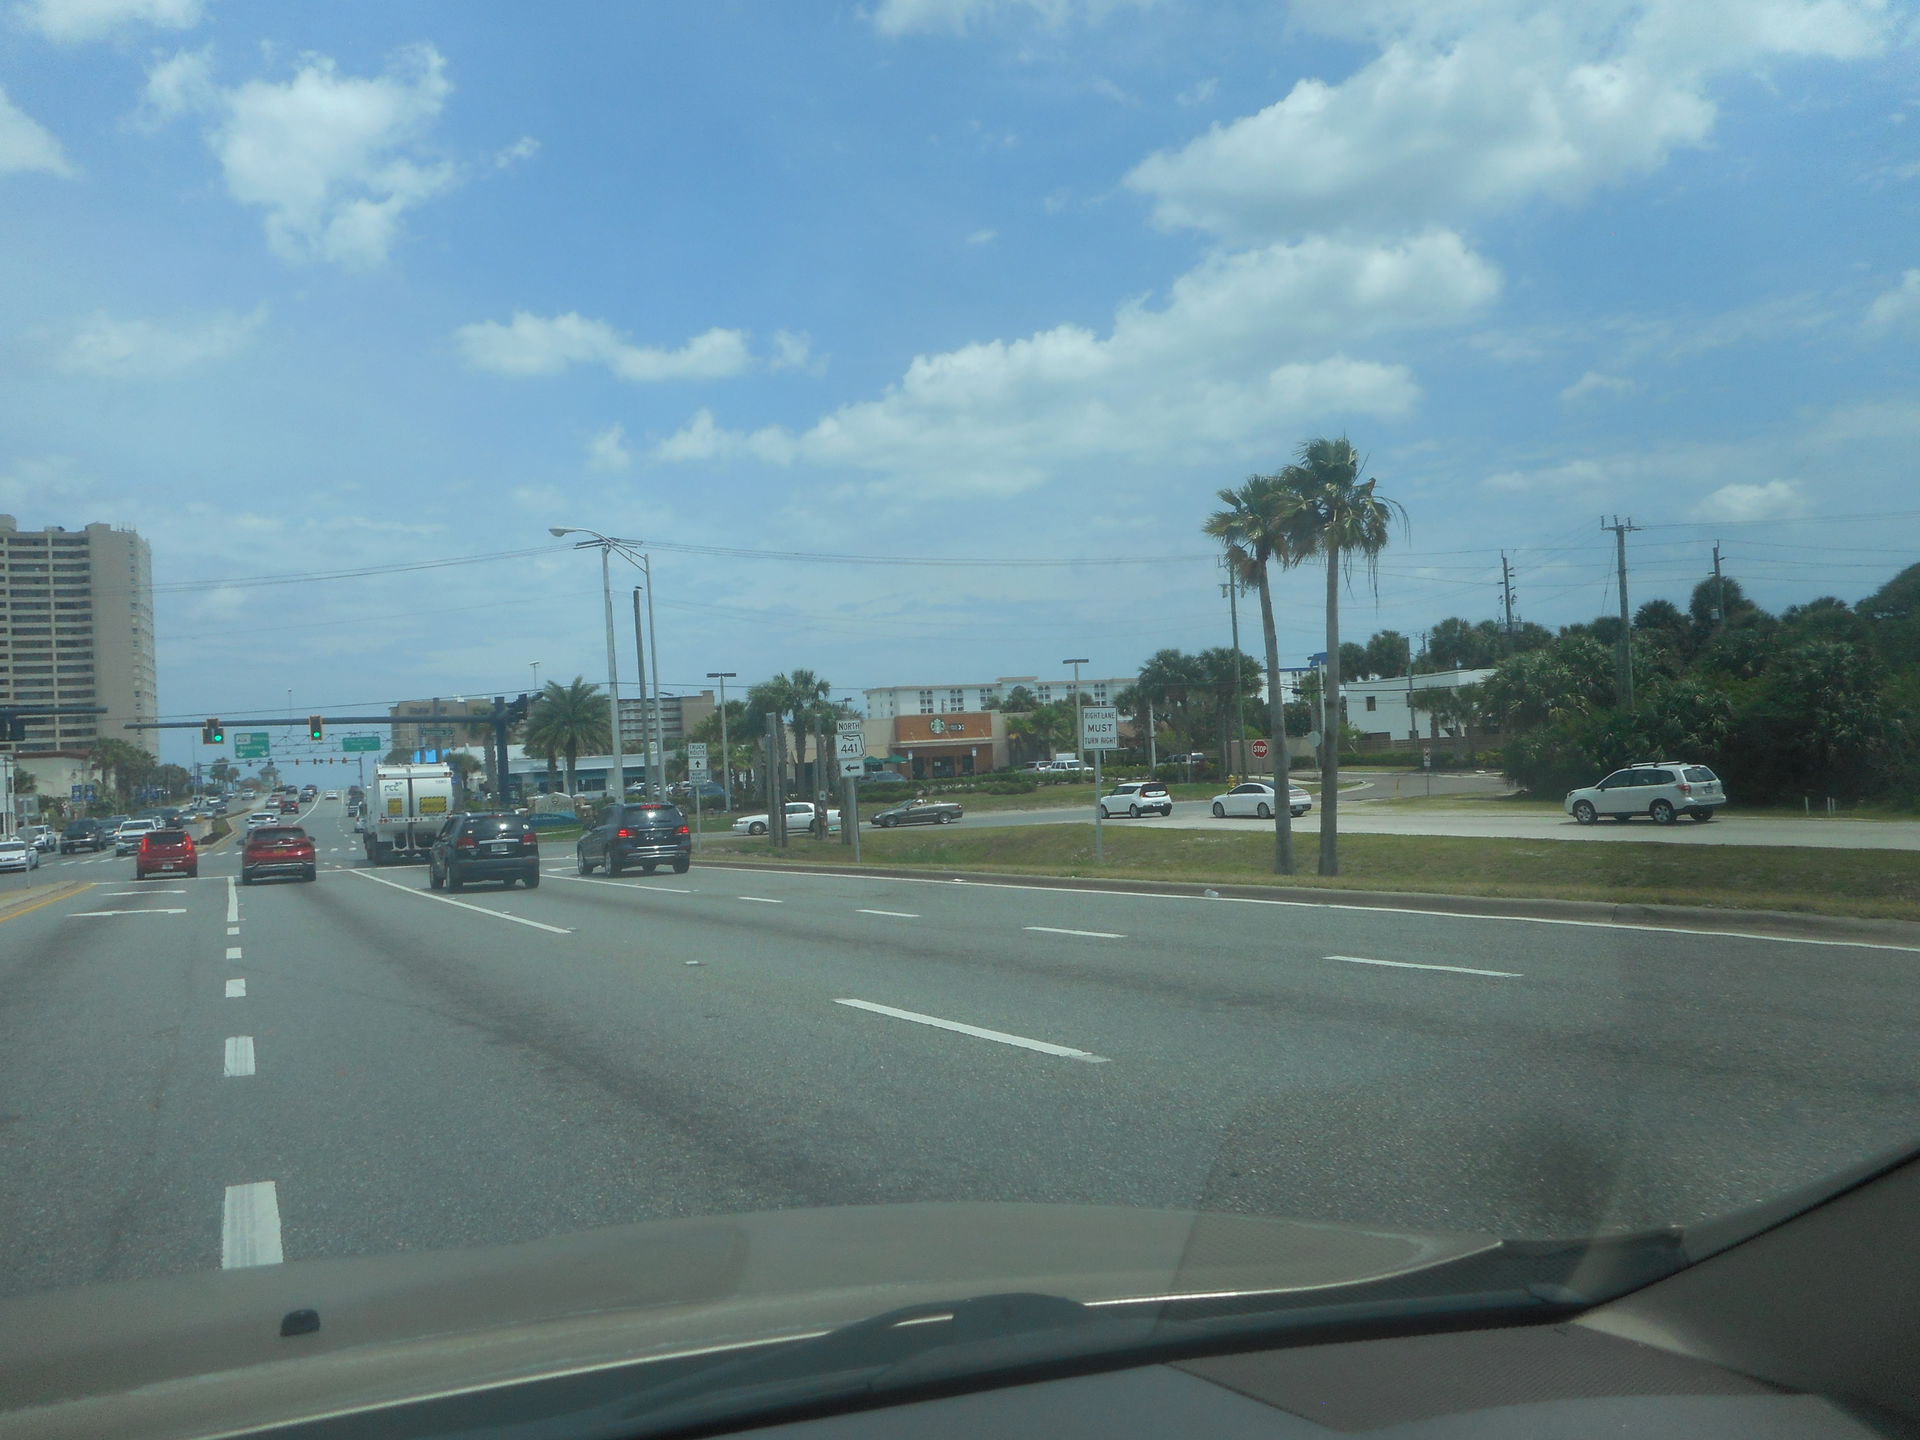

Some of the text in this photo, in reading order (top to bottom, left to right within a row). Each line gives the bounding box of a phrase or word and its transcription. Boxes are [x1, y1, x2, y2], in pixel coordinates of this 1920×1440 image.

[838, 722, 860, 731] NORTH
[1087, 723, 1113, 733] MUST
[841, 743, 858, 753] 441
[1253, 745, 1267, 753] STOP
